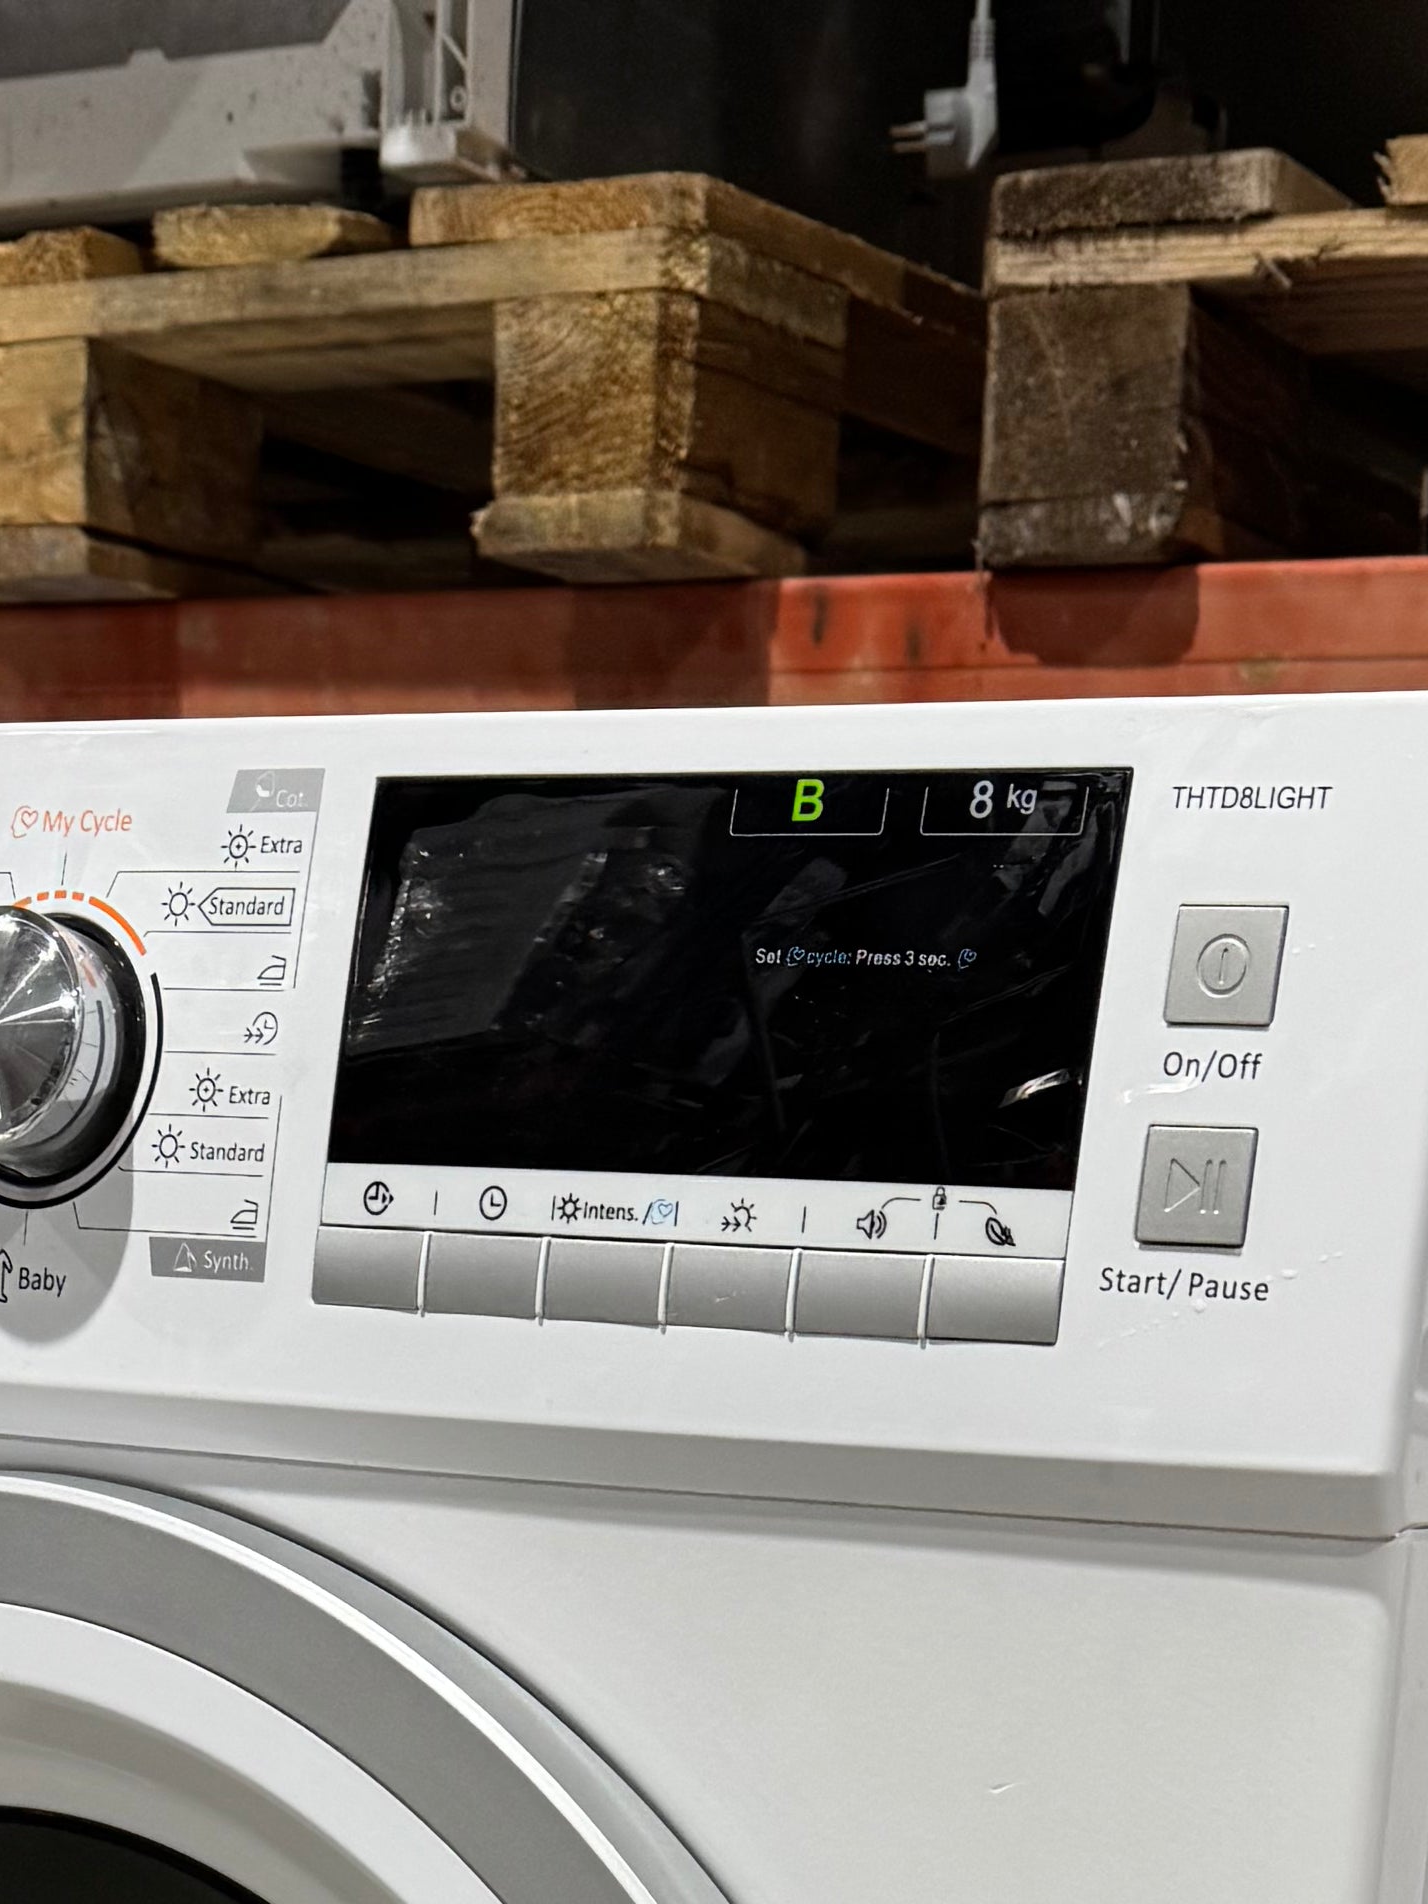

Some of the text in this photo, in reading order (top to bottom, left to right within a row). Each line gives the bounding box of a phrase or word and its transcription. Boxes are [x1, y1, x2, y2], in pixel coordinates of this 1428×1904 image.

[791, 778, 825, 822] B
[969, 780, 1038, 819] 8 kg
[1172, 786, 1334, 810] THTD8LIGHT
[43, 808, 133, 837] My Cycle
[260, 835, 303, 854] Extra
[208, 895, 285, 915] Standard
[905, 950, 915, 966] 3
[1162, 1050, 1263, 1083] On/Off
[228, 1086, 271, 1105] Extra
[190, 1141, 265, 1162] Standard
[203, 1250, 255, 1273] Synth.
[18, 1267, 67, 1298] Baby
[1188, 1272, 1270, 1301] Pause
